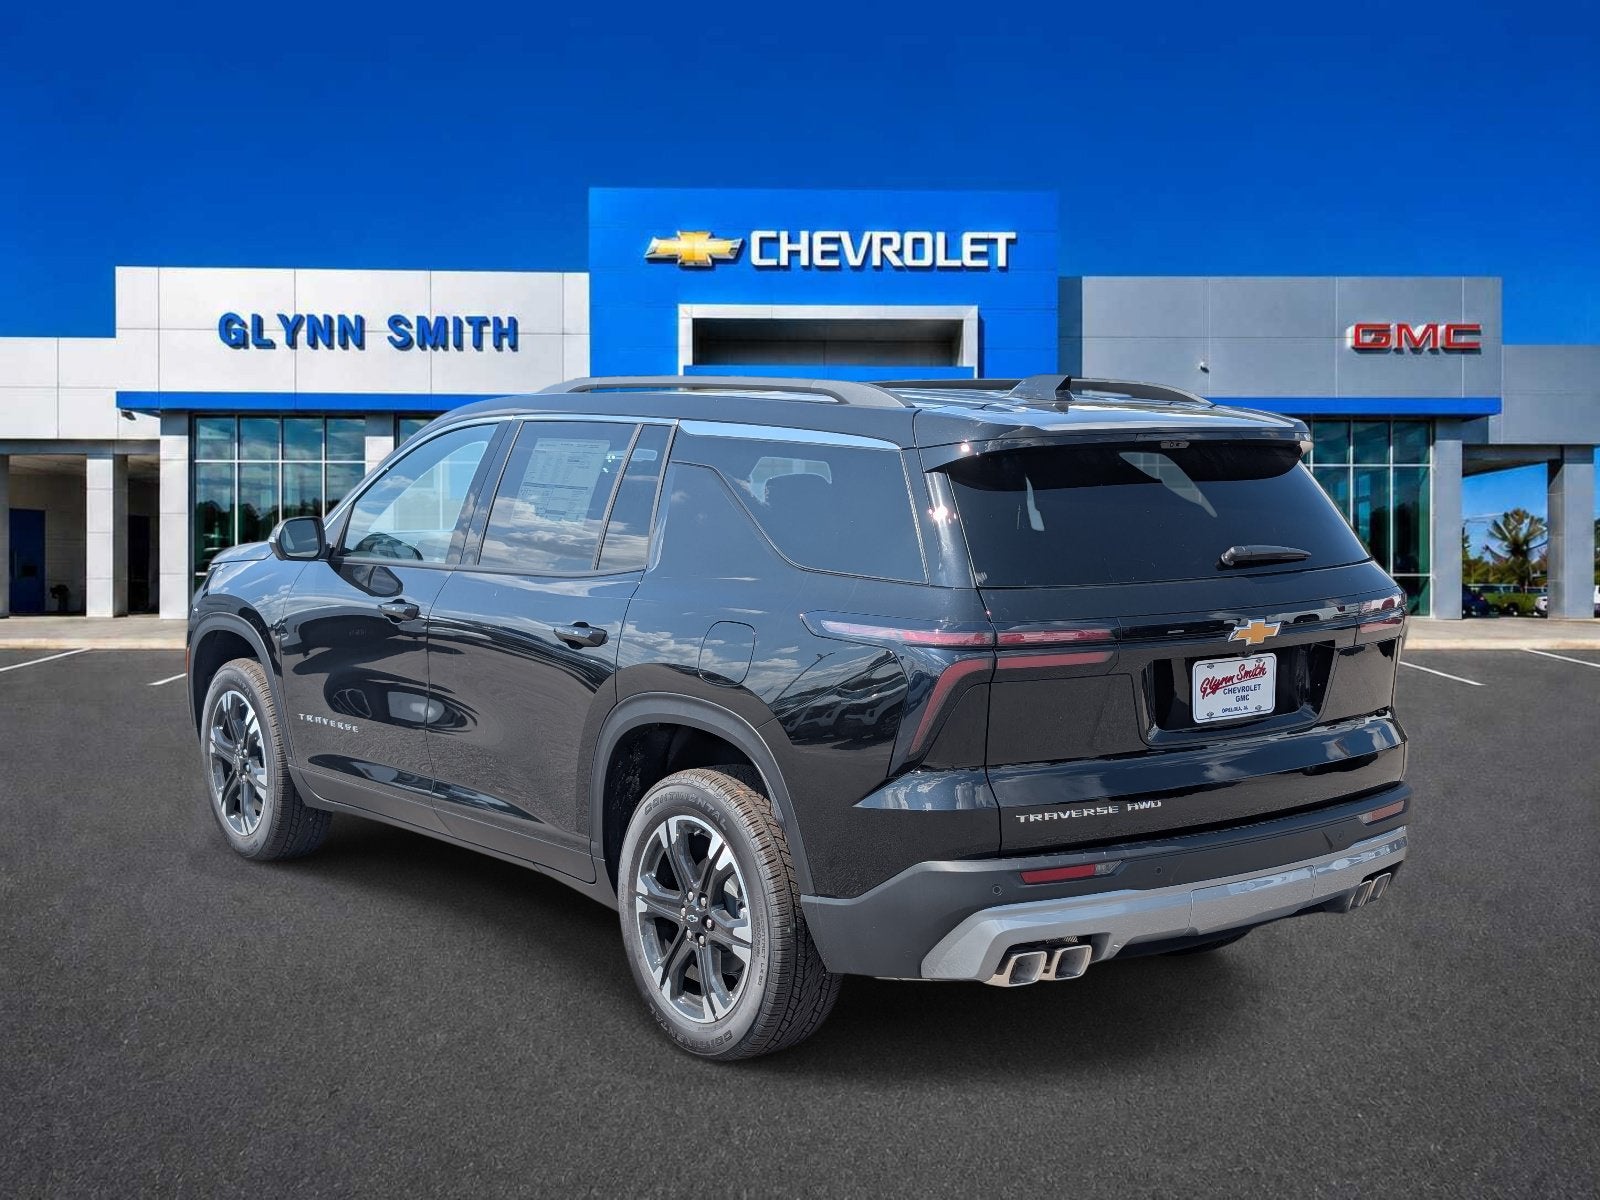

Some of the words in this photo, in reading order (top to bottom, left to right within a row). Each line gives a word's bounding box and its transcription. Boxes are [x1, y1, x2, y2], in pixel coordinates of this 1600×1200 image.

[750, 230, 1017, 269] CHEVROLET
[218, 312, 365, 350] GLYNN
[387, 314, 519, 352] SMITH
[1347, 323, 1482, 352] GMC
[1200, 675, 1236, 700] Glynn
[1236, 661, 1267, 680] Smith
[1223, 684, 1262, 695] CHEVROLET
[1235, 694, 1250, 703] GMC
[298, 713, 359, 733] TRAVERSE
[1015, 805, 1120, 823] TRAVERSE
[1127, 800, 1162, 812] AWD
